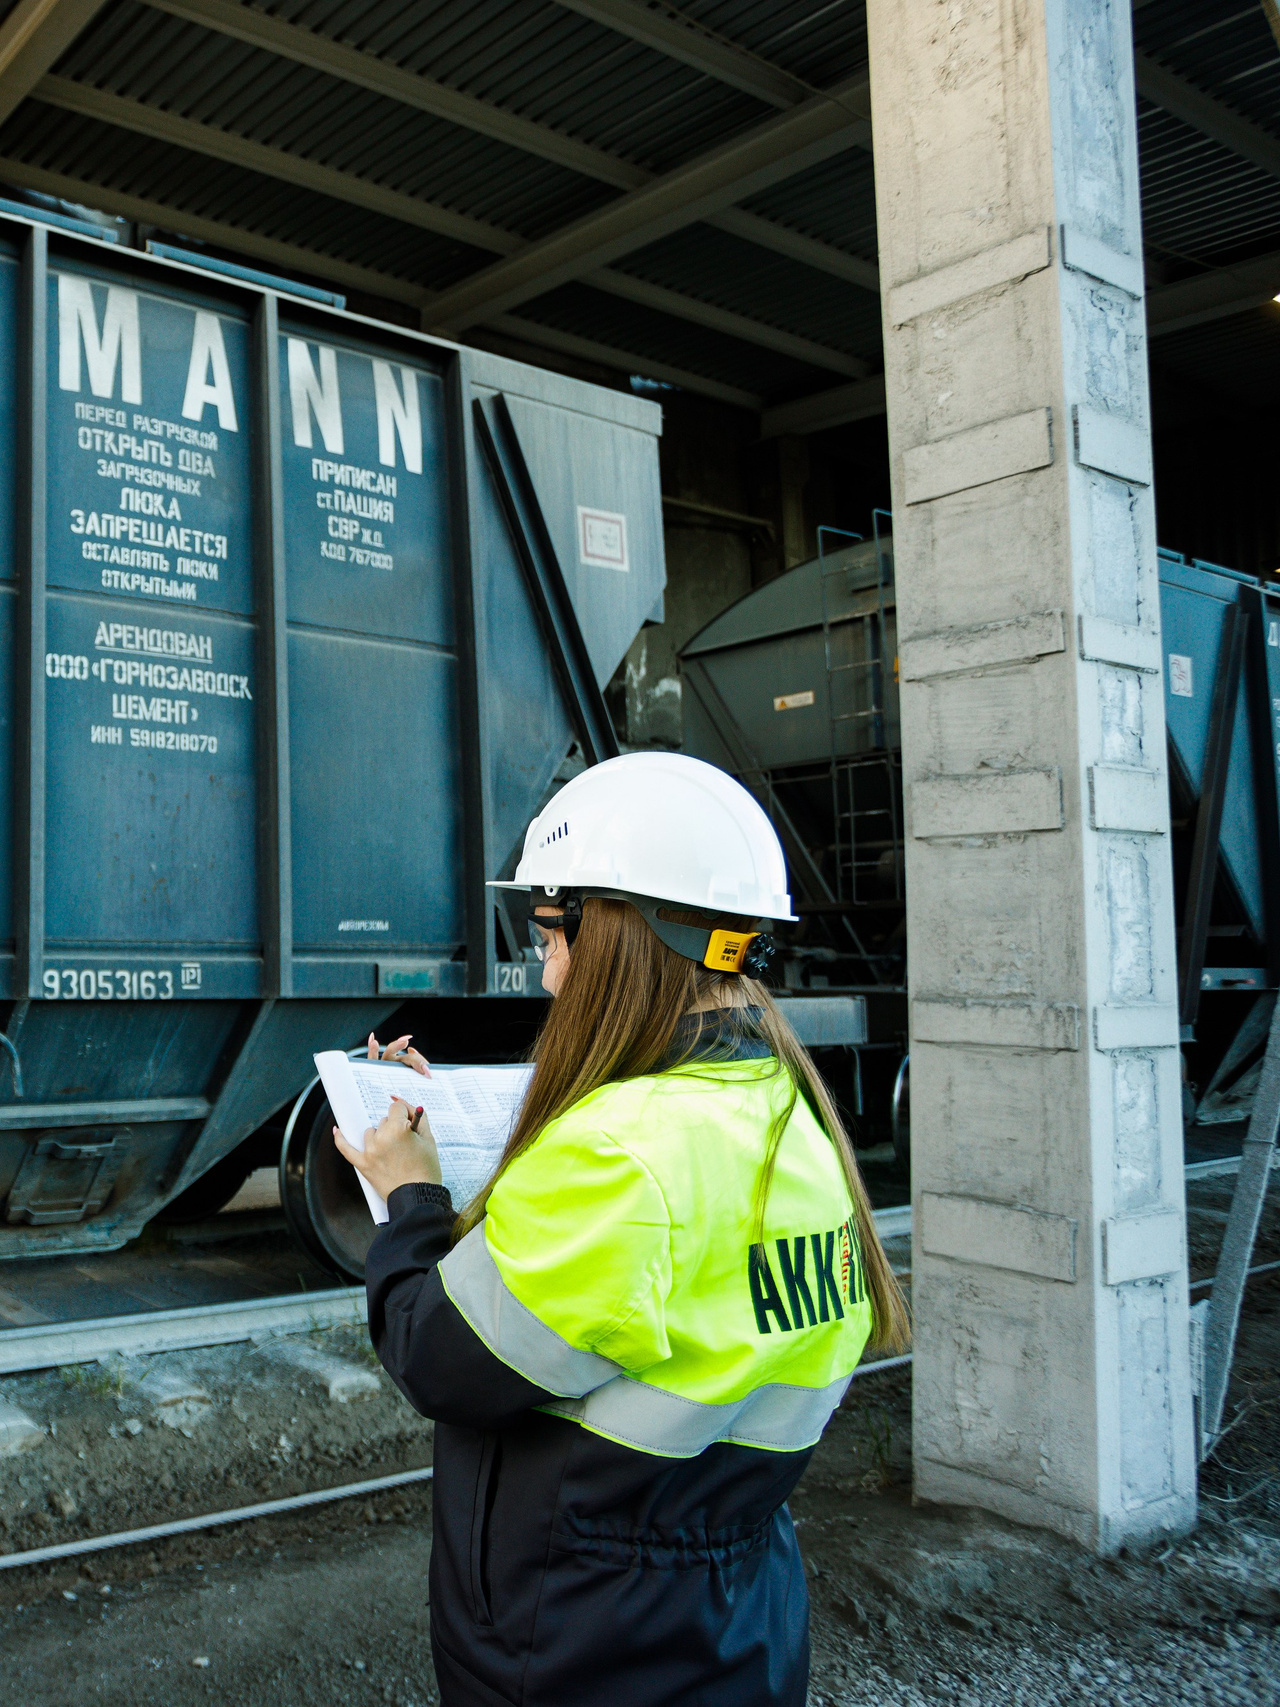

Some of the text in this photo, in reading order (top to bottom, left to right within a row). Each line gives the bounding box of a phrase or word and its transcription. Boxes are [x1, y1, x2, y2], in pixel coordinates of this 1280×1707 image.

[74, 402, 219, 452] ПЕРЕД РАЗГРУЗКОЙ
[78, 426, 217, 479] ОТКРЫТЬ ДВА
[97, 458, 202, 497] ЗАГРУЗОЧНЫХ
[311, 457, 397, 499] ПРИПИСАН
[120, 487, 182, 521] ЛЮКА
[70, 509, 228, 560] ЗАПРЕЩАЕТСЯ
[328, 515, 360, 541] СВР
[82, 541, 219, 581] ОСТАВЛЯТЬ ЛЮКИ
[101, 569, 197, 601] ОТКРЫТЫМИ
[94, 621, 213, 661] АРЕНДОВАН
[45, 653, 89, 681] ООО
[90, 725, 218, 754] ИНН 5918218070
[42, 969, 174, 1000] 93053163
[500, 965, 523, 993] 20
